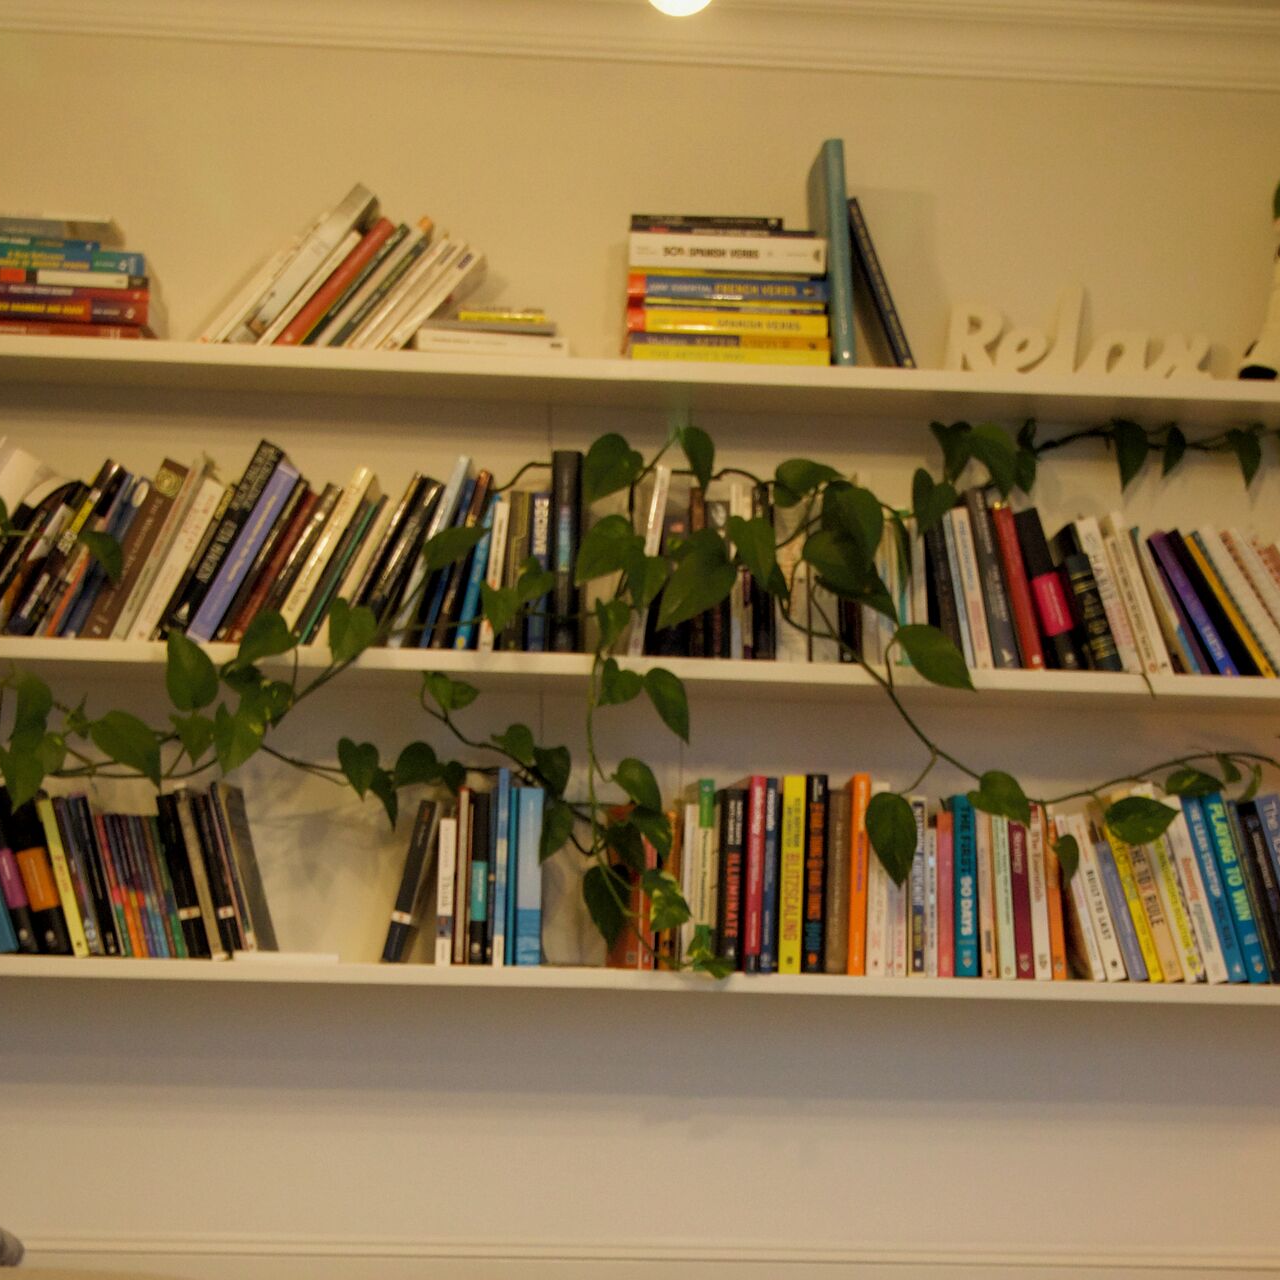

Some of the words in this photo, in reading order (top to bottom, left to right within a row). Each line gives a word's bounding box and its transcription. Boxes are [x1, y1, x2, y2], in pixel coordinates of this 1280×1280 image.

[944, 284, 1212, 374] Relax
[960, 806, 969, 833] THE
[1209, 801, 1235, 863] PLAYING
[961, 836, 970, 873] FIRST
[961, 876, 971, 897] 90
[1203, 853, 1221, 897] STARTUP
[1226, 866, 1241, 888] TO
[724, 852, 739, 938] ILLUMINATE
[783, 853, 799, 941] BLITZSCALING
[1087, 870, 1098, 897] BUILT
[1096, 901, 1104, 913] TO
[1100, 917, 1110, 940] LAST
[1144, 895, 1163, 927] RULE
[1232, 889, 1251, 922] WIN
[961, 898, 972, 936] DAYS
